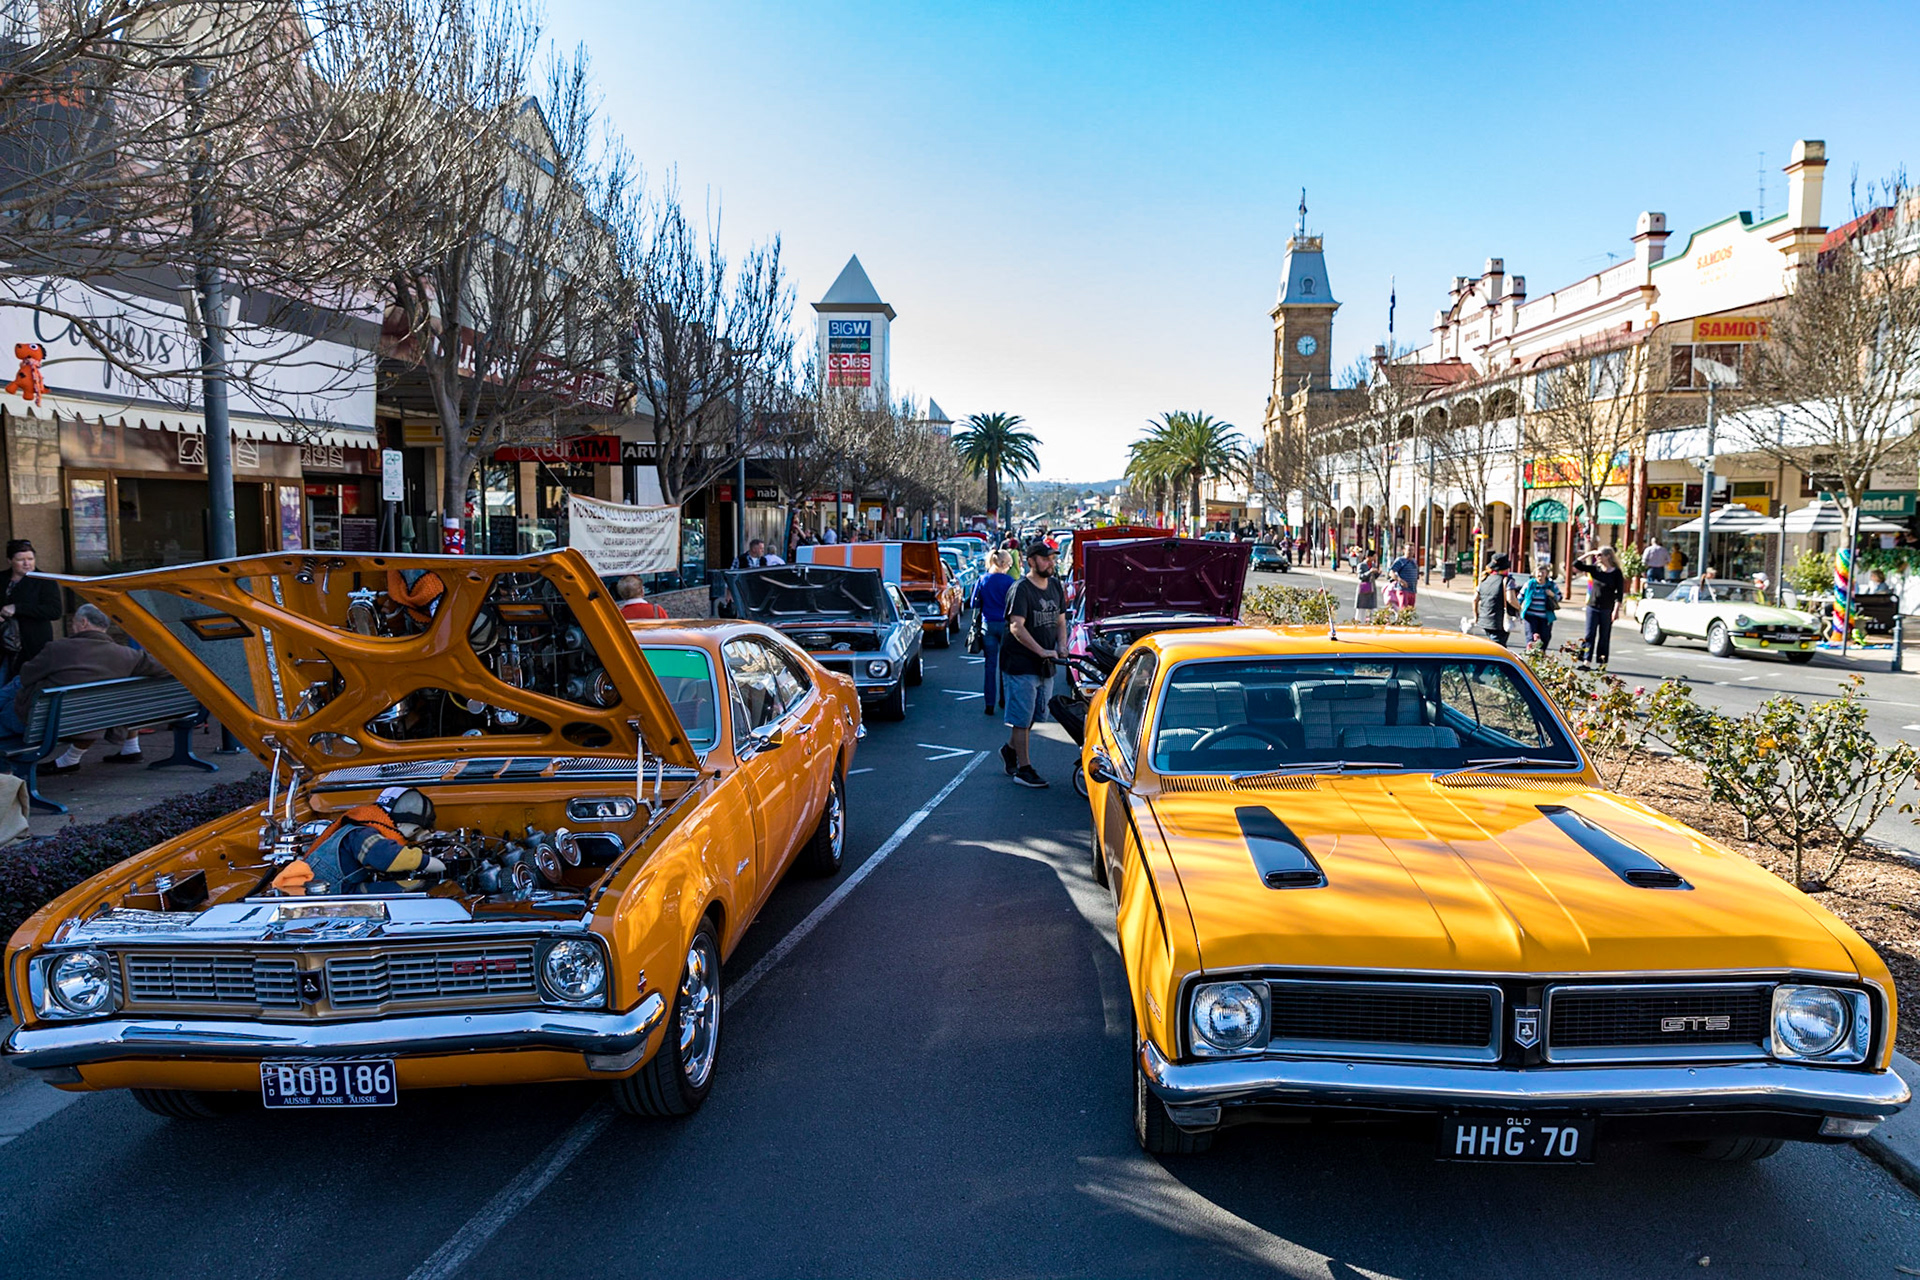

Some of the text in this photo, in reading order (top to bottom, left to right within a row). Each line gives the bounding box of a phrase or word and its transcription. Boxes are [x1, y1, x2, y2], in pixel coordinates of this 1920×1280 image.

[830, 354, 870, 368] coles
[385, 453, 401, 466] 2P
[757, 488, 777, 498] nab
[453, 958, 517, 974] GTS
[1661, 1015, 1731, 1032] GTS
[283, 1095, 378, 1105] AUSSIE AUSSIE AUSSIE
[1506, 1117, 1532, 1126] QLD
